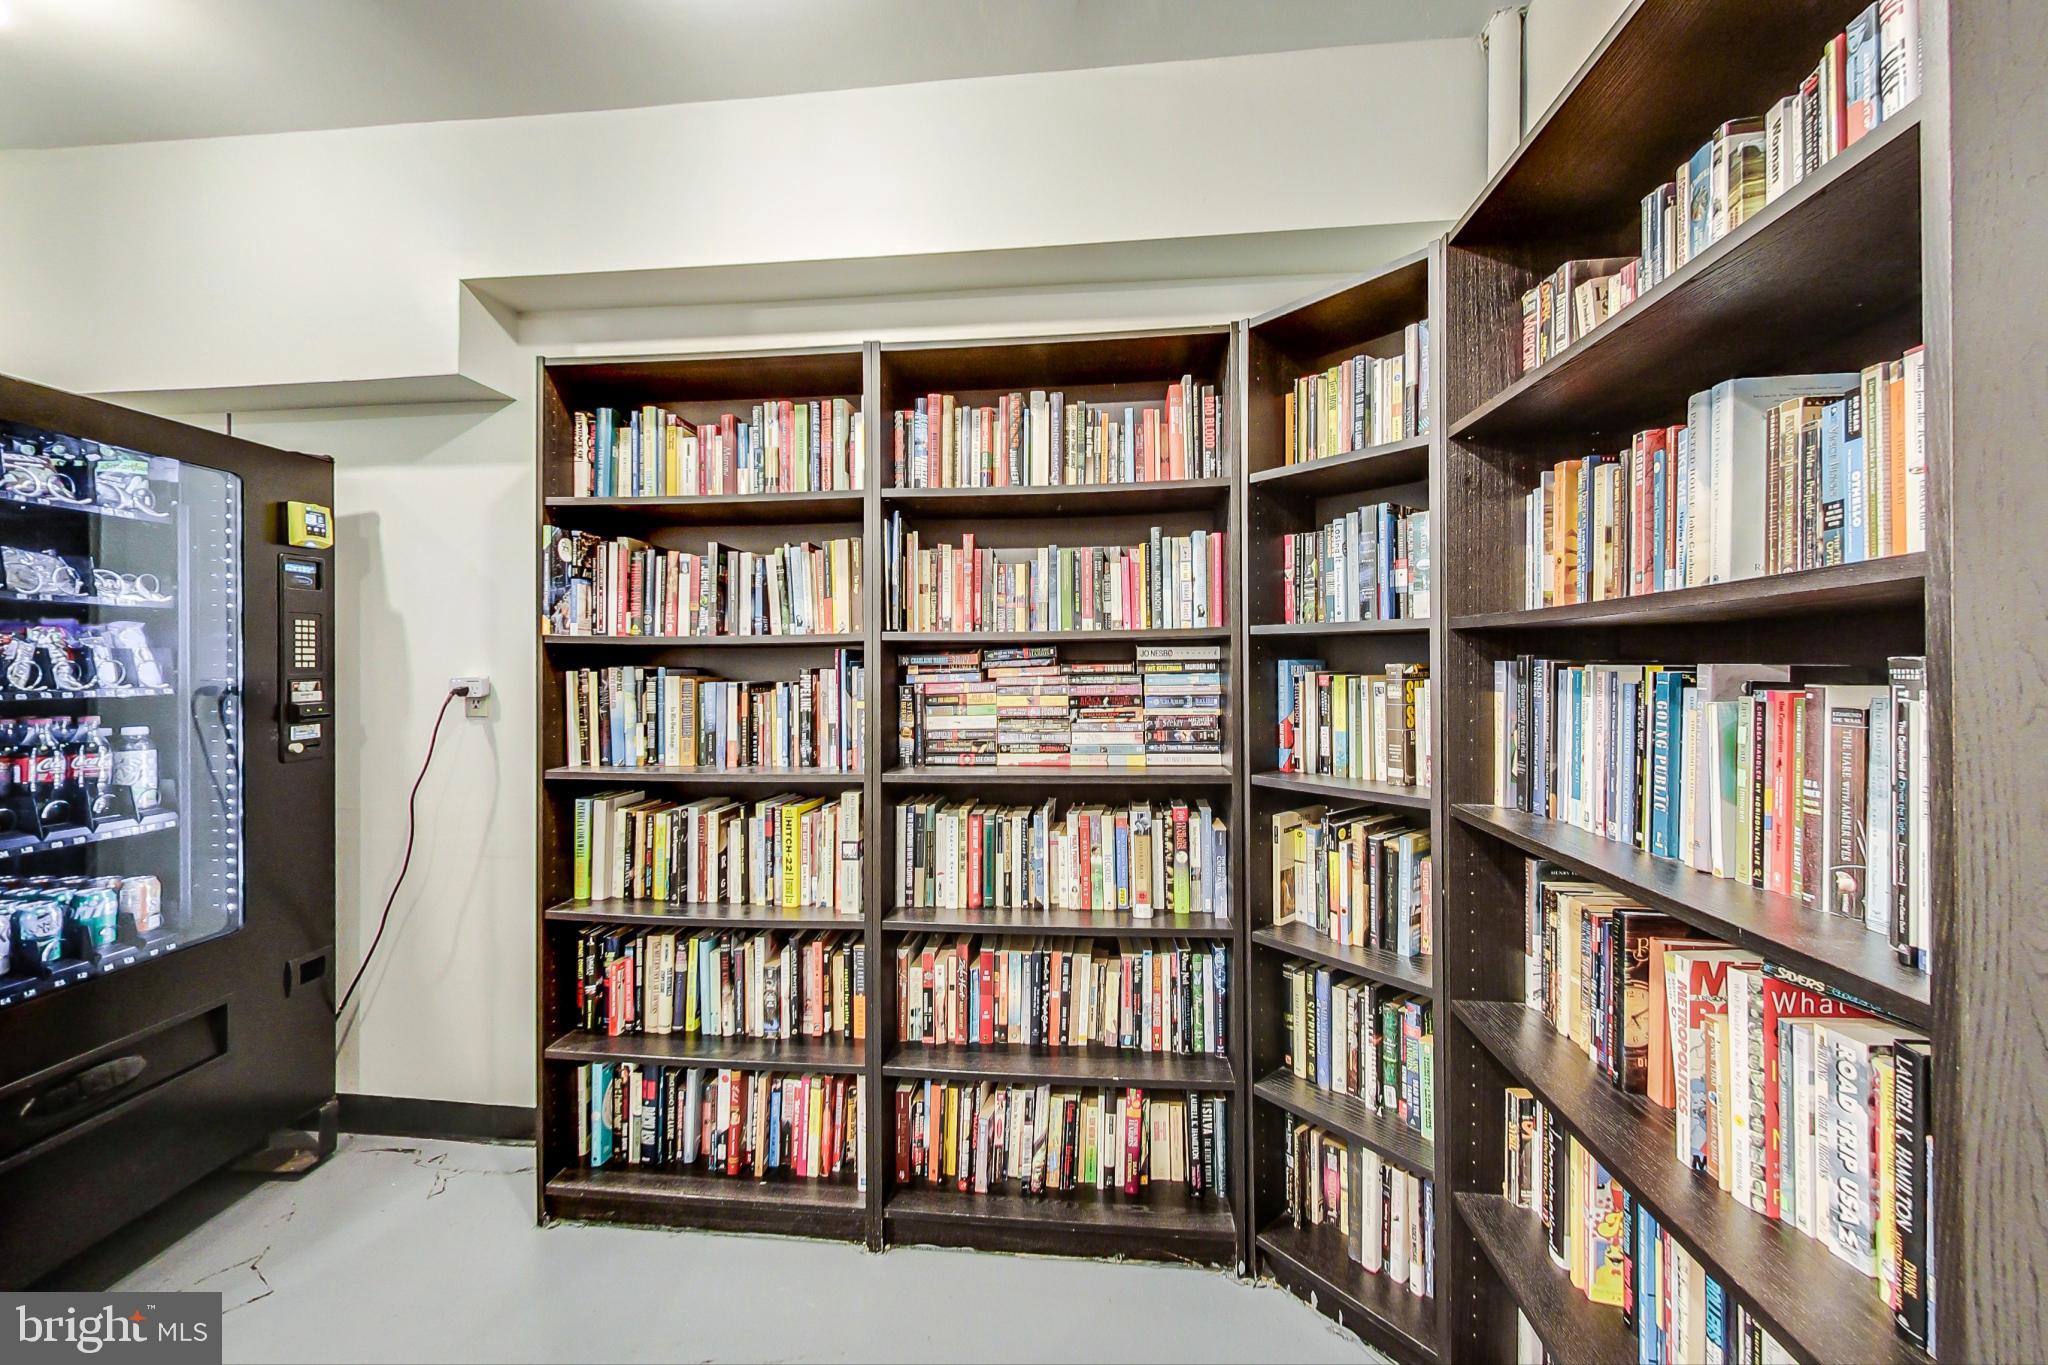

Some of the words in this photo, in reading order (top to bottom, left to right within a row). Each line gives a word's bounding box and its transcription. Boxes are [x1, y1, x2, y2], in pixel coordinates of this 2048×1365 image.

[1772, 118, 1782, 183] Woman
[1542, 283, 1551, 322] DARK
[1523, 313, 1537, 370] MAGICIAN
[1355, 361, 1364, 392] CHOOSING
[1204, 396, 1214, 415] BAD
[1853, 396, 1859, 409] NO
[1916, 391, 1924, 410] from
[1205, 418, 1215, 448] BLOOD
[1804, 445, 1815, 466] Pride
[1679, 480, 1686, 505] ME
[1785, 476, 1793, 505] WORLD
[1804, 481, 1816, 518] Prejudice
[1852, 471, 1861, 527] OTHELLO
[800, 675, 811, 712] PIPELINE
[1655, 701, 1668, 748] GOING
[1777, 713, 1785, 752] Corporation
[1841, 729, 1852, 749] THE
[1898, 721, 1906, 734] The
[1875, 721, 1885, 759] History
[1898, 736, 1906, 769] Cathedral
[1841, 753, 1852, 778] HARE
[1898, 772, 1906, 780] of
[1654, 754, 1668, 813] PUBLIC
[1755, 783, 1761, 794] MY
[1898, 781, 1906, 805] Christ
[577, 801, 585, 827] PATRICIA
[1841, 804, 1851, 836] AMBER
[1896, 818, 1906, 835] Light
[577, 828, 585, 858] CORNWELL
[1794, 827, 1802, 845] ANNE
[1841, 838, 1851, 862] EYES
[1793, 848, 1802, 875] LAMOTT
[1771, 992, 1846, 1014] What
[1307, 1001, 1315, 1057] SACRIFICE
[1677, 980, 1688, 1116] METROPOLITICS
[1836, 1043, 1857, 1113] ROAD
[1896, 1055, 1913, 1121] LAURELL
[1190, 1094, 1198, 1119] LAURELL
[1202, 1108, 1213, 1134] SILVA
[1818, 1096, 1828, 1132] GEORGE
[1191, 1128, 1199, 1160] HAMILTON
[1836, 1119, 1857, 1173] TRIP
[1896, 1124, 1913, 1138] K.
[1838, 1177, 1858, 1224] USA
[1896, 1145, 1913, 1233] HAMILTON
[1904, 1259, 1917, 1300] DIVINE
